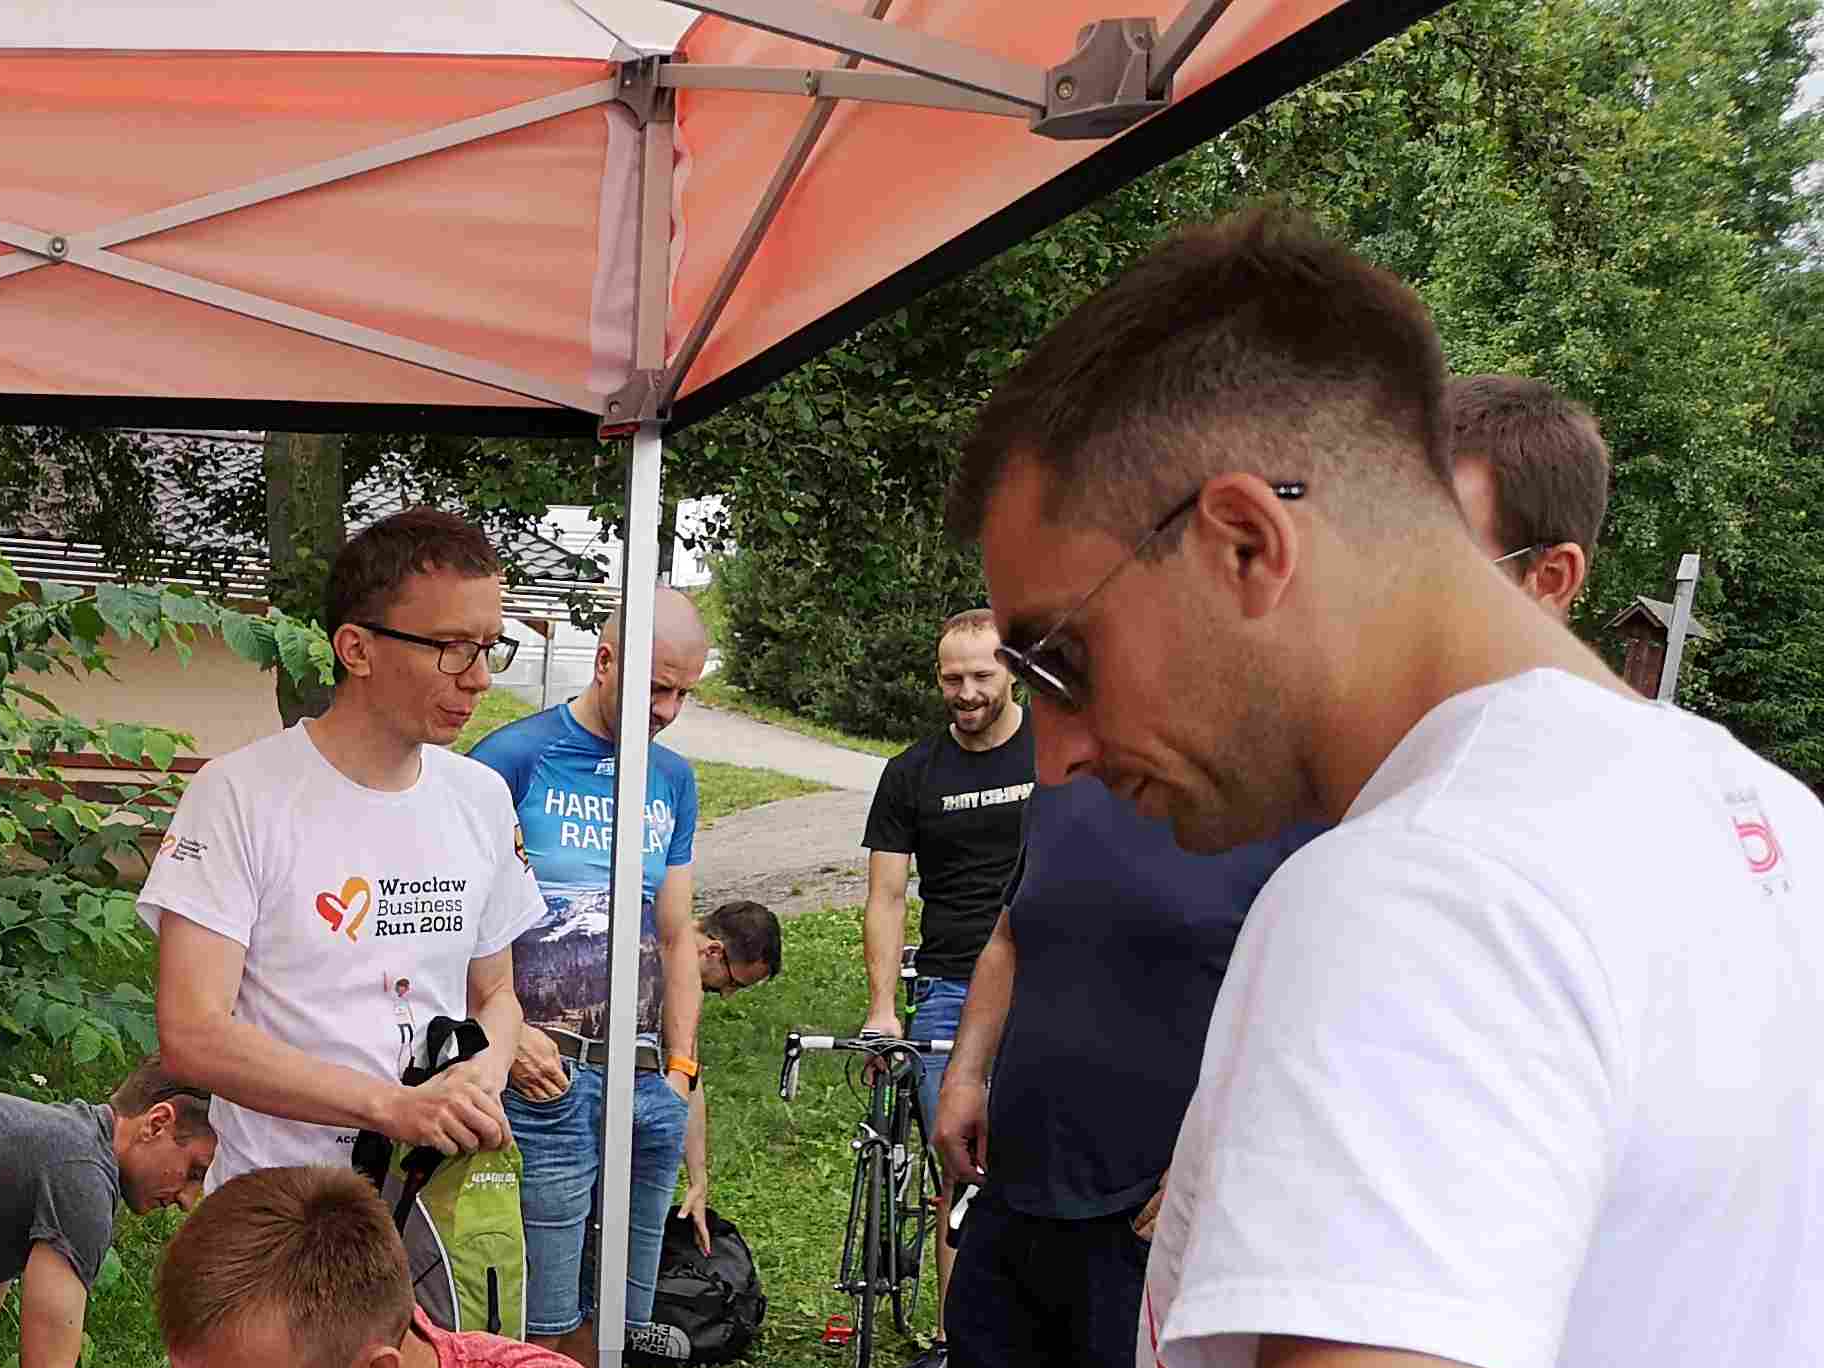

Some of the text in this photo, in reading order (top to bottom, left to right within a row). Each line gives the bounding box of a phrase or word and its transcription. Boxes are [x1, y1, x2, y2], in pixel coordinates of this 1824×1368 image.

[376, 896, 463, 917] Business
[375, 915, 464, 937] Run 2018
